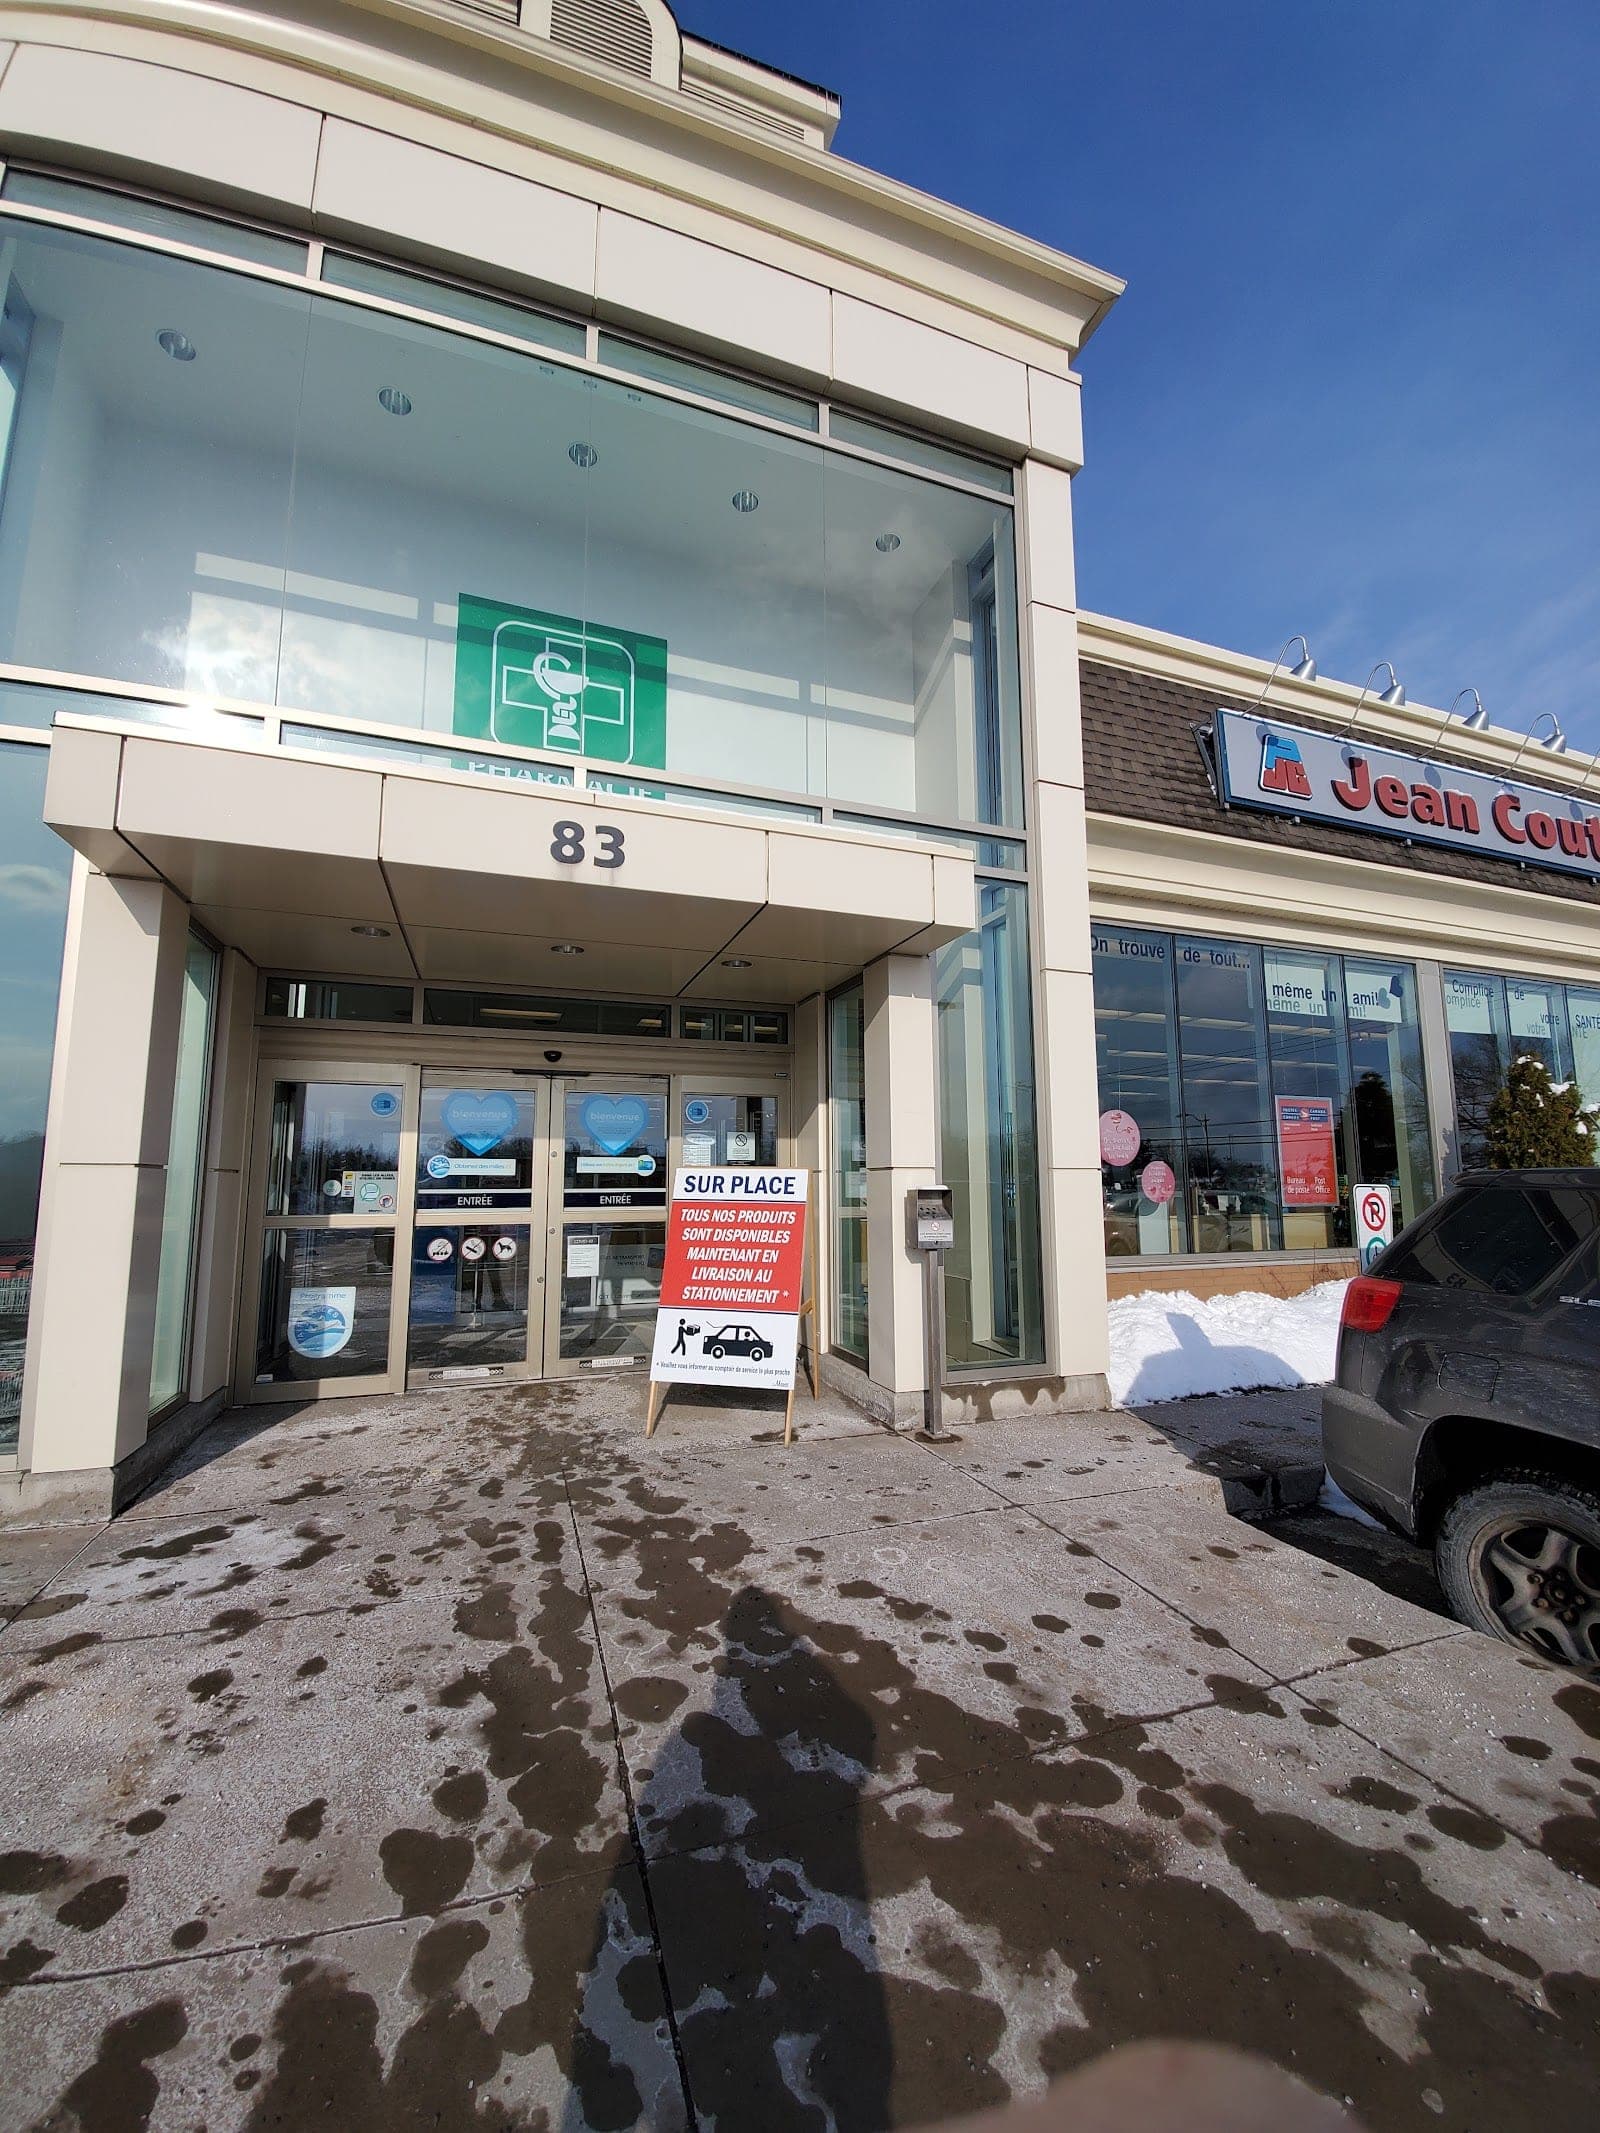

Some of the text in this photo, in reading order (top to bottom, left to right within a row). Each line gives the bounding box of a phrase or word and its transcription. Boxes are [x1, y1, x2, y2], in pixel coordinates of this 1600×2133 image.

[1331, 756, 1480, 834] Jean
[550, 820, 626, 868] 83
[1118, 938, 1165, 959] trouve
[1183, 946, 1200, 963] de
[1210, 951, 1250, 968] tout...
[1272, 982, 1379, 1006] même un ami!
[1452, 979, 1525, 1000] Complice de
[1540, 1012, 1560, 1025] votre
[452, 1109, 508, 1119] bienvenue
[590, 1111, 640, 1121] bienvenue
[684, 1175, 796, 1195] SUR PLACE
[1286, 1176, 1306, 1184] Bureau
[1314, 1176, 1326, 1184] Post
[1287, 1186, 1310, 1195] de poste
[1315, 1186, 1331, 1194] Office
[457, 1195, 493, 1206] ENTRÉE
[600, 1194, 632, 1205] ENTRÉE
[681, 1208, 796, 1225] TOUS NOS PRODUITS
[682, 1227, 791, 1244] SONT DISPONIBLES
[686, 1246, 779, 1263] MAINTENANT EN
[691, 1266, 773, 1283] LIVRAISON AU
[682, 1286, 779, 1304] STATIONNEMENT
[660, 1361, 677, 1369] Veuillez
[715, 1365, 734, 1373] comptoir
